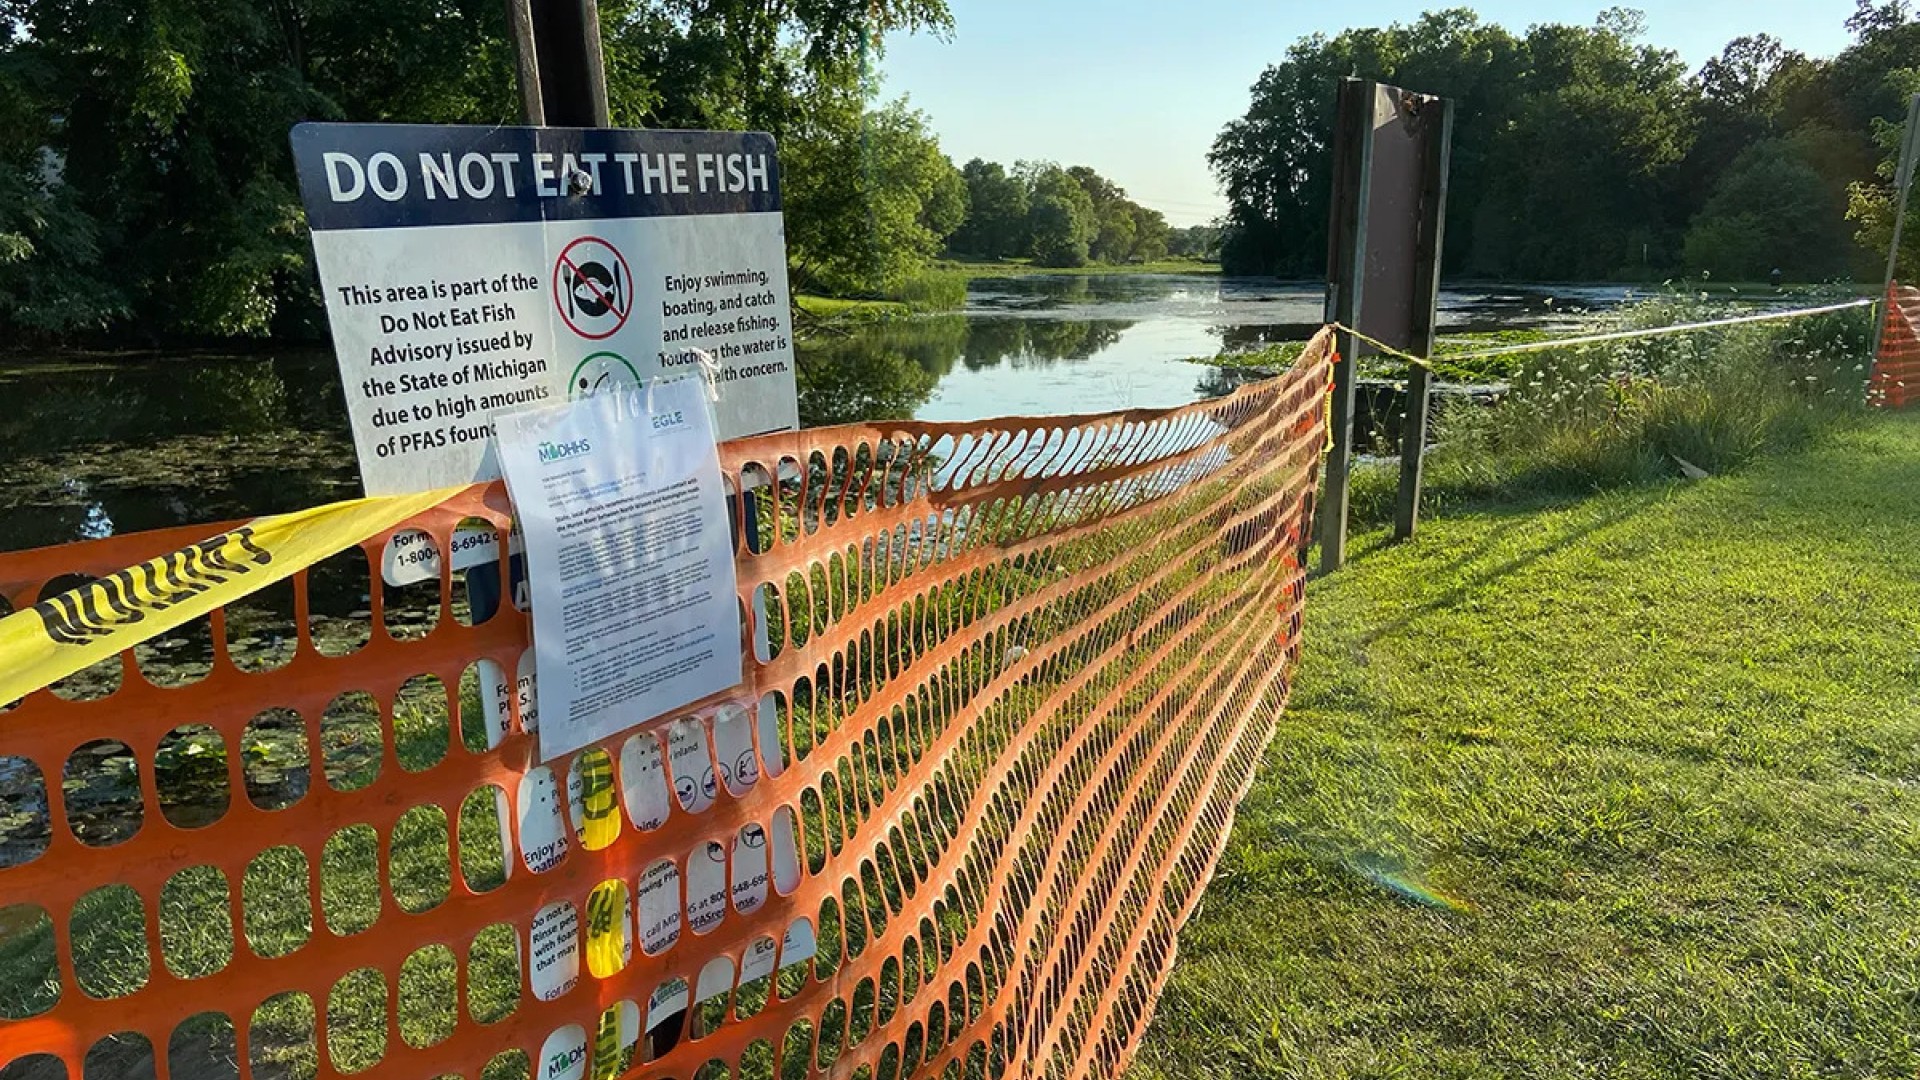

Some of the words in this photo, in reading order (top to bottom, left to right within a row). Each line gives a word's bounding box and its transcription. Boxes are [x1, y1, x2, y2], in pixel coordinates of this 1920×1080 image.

[323, 152, 408, 201] DO
[418, 152, 519, 200] NOT
[535, 153, 602, 196] EAT
[615, 153, 689, 195] THE
[700, 153, 769, 192] FISH
[338, 284, 382, 305] This
[386, 287, 428, 302] area
[431, 280, 447, 298] is
[451, 277, 489, 301] part
[492, 274, 508, 293] of
[511, 272, 539, 290] the
[665, 274, 701, 294] Enjoy
[705, 268, 769, 287] swimming,
[663, 298, 717, 316] boating,
[720, 293, 742, 310] and
[745, 290, 775, 307] catch
[381, 314, 409, 334] Do
[412, 311, 448, 331] Not
[450, 308, 480, 327] Eat
[481, 303, 516, 323] Fish
[663, 324, 688, 342] and
[691, 321, 735, 338] release
[737, 316, 780, 332] fishing.
[370, 342, 453, 366] Advisory
[456, 331, 511, 355] issued
[513, 330, 534, 350] by
[658, 346, 718, 368] Touchg
[720, 342, 740, 358] the
[742, 339, 775, 354] water
[777, 335, 787, 349] is
[362, 378, 396, 398] the
[399, 372, 448, 393] State
[452, 365, 470, 385] of
[474, 358, 547, 381] Michigan
[740, 360, 788, 379] concern.
[372, 408, 409, 428] due
[412, 405, 432, 421] to
[436, 394, 476, 419] high
[480, 384, 549, 410] amounts
[652, 411, 684, 429] EGLE
[376, 436, 396, 458] of
[400, 429, 446, 453] PFAS
[393, 534, 414, 549] For
[533, 925, 558, 944] Rinse
[534, 940, 556, 957] with
[536, 954, 556, 972] that
[557, 942, 577, 959] may
